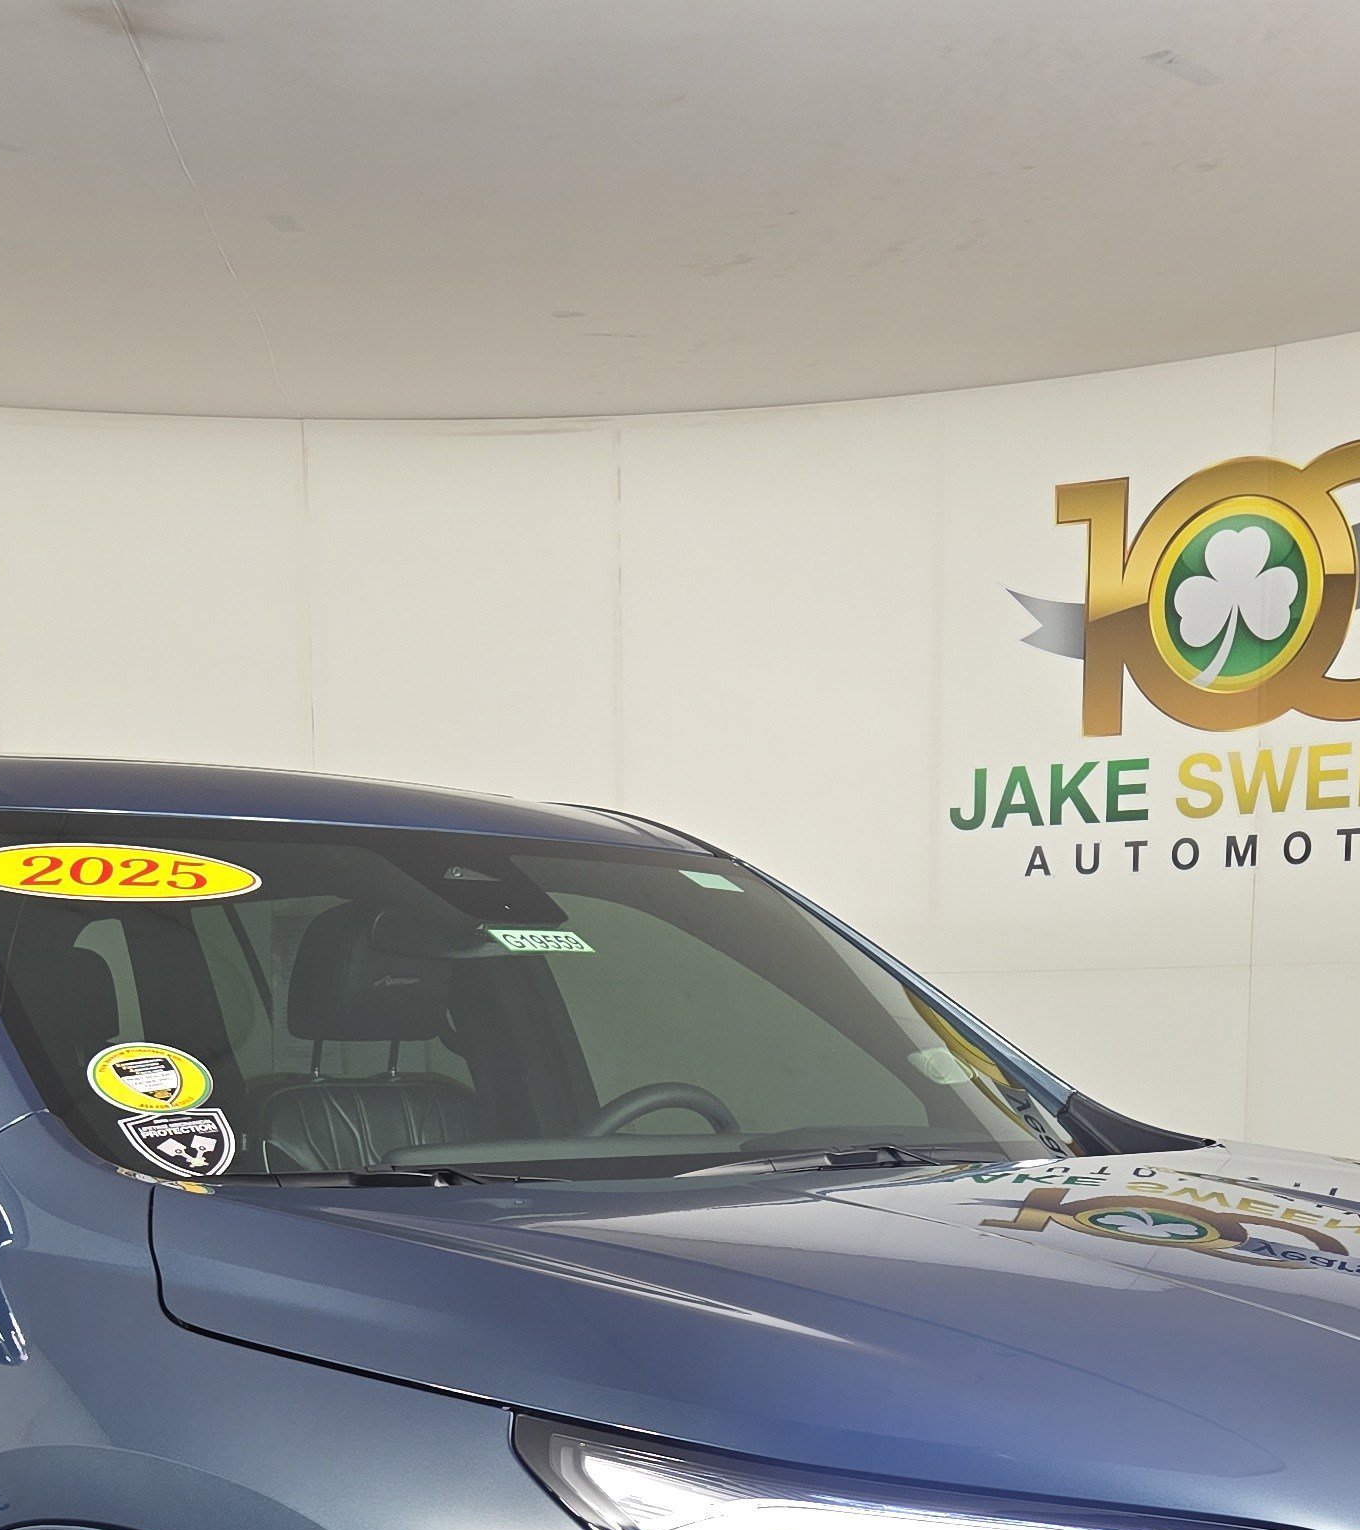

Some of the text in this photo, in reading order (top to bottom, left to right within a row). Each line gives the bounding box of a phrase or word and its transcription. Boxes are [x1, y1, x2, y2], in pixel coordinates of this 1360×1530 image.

[949, 757, 1151, 832] JAKE
[20, 854, 209, 891] 2025
[502, 933, 585, 950] G19559
[140, 1122, 218, 1139] PROTECTION
